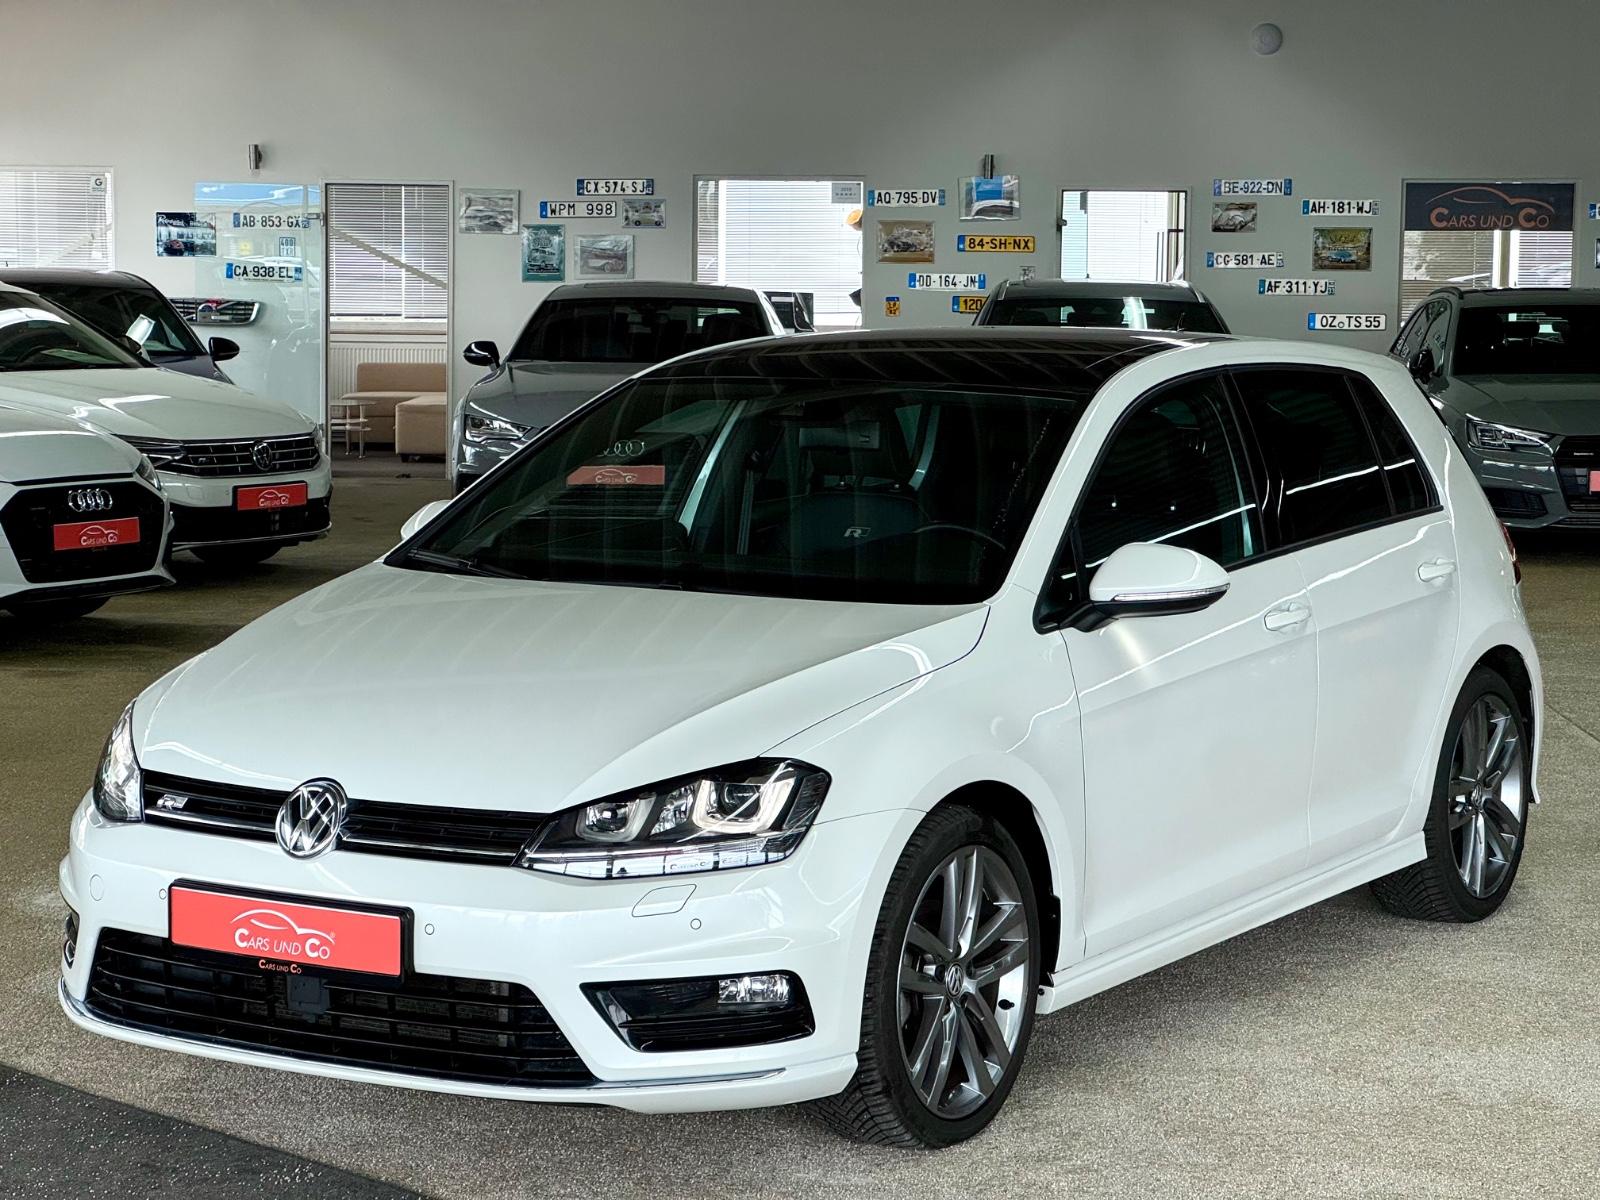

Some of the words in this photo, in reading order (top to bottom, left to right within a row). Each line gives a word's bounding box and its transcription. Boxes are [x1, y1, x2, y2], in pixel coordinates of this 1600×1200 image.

[585, 181, 645, 193] CX-574-SJ
[1223, 181, 1283, 194] BE-922-DN
[876, 191, 937, 204] AQ-795-DV
[549, 203, 576, 216] WPM
[586, 203, 613, 216] 998
[1310, 201, 1372, 214] AH-181-WJ
[242, 214, 301, 228] AB-853-GX
[1430, 207, 1477, 228] CARS
[1480, 214, 1514, 228] UND
[1518, 207, 1550, 228] CO
[968, 237, 1031, 250] 84-SH-NX
[1215, 254, 1275, 266] CG-581-AE
[233, 265, 293, 279] CA-938-EL
[918, 275, 977, 288] DD-164-JN
[1266, 281, 1328, 294] AF-311-YJ
[1345, 315, 1362, 328] TS
[1365, 315, 1381, 328] 55
[234, 927, 270, 952] CARS
[273, 940, 301, 956] UND
[305, 938, 330, 959] CO
[258, 960, 276, 971] CARS
[290, 964, 302, 975] CO
